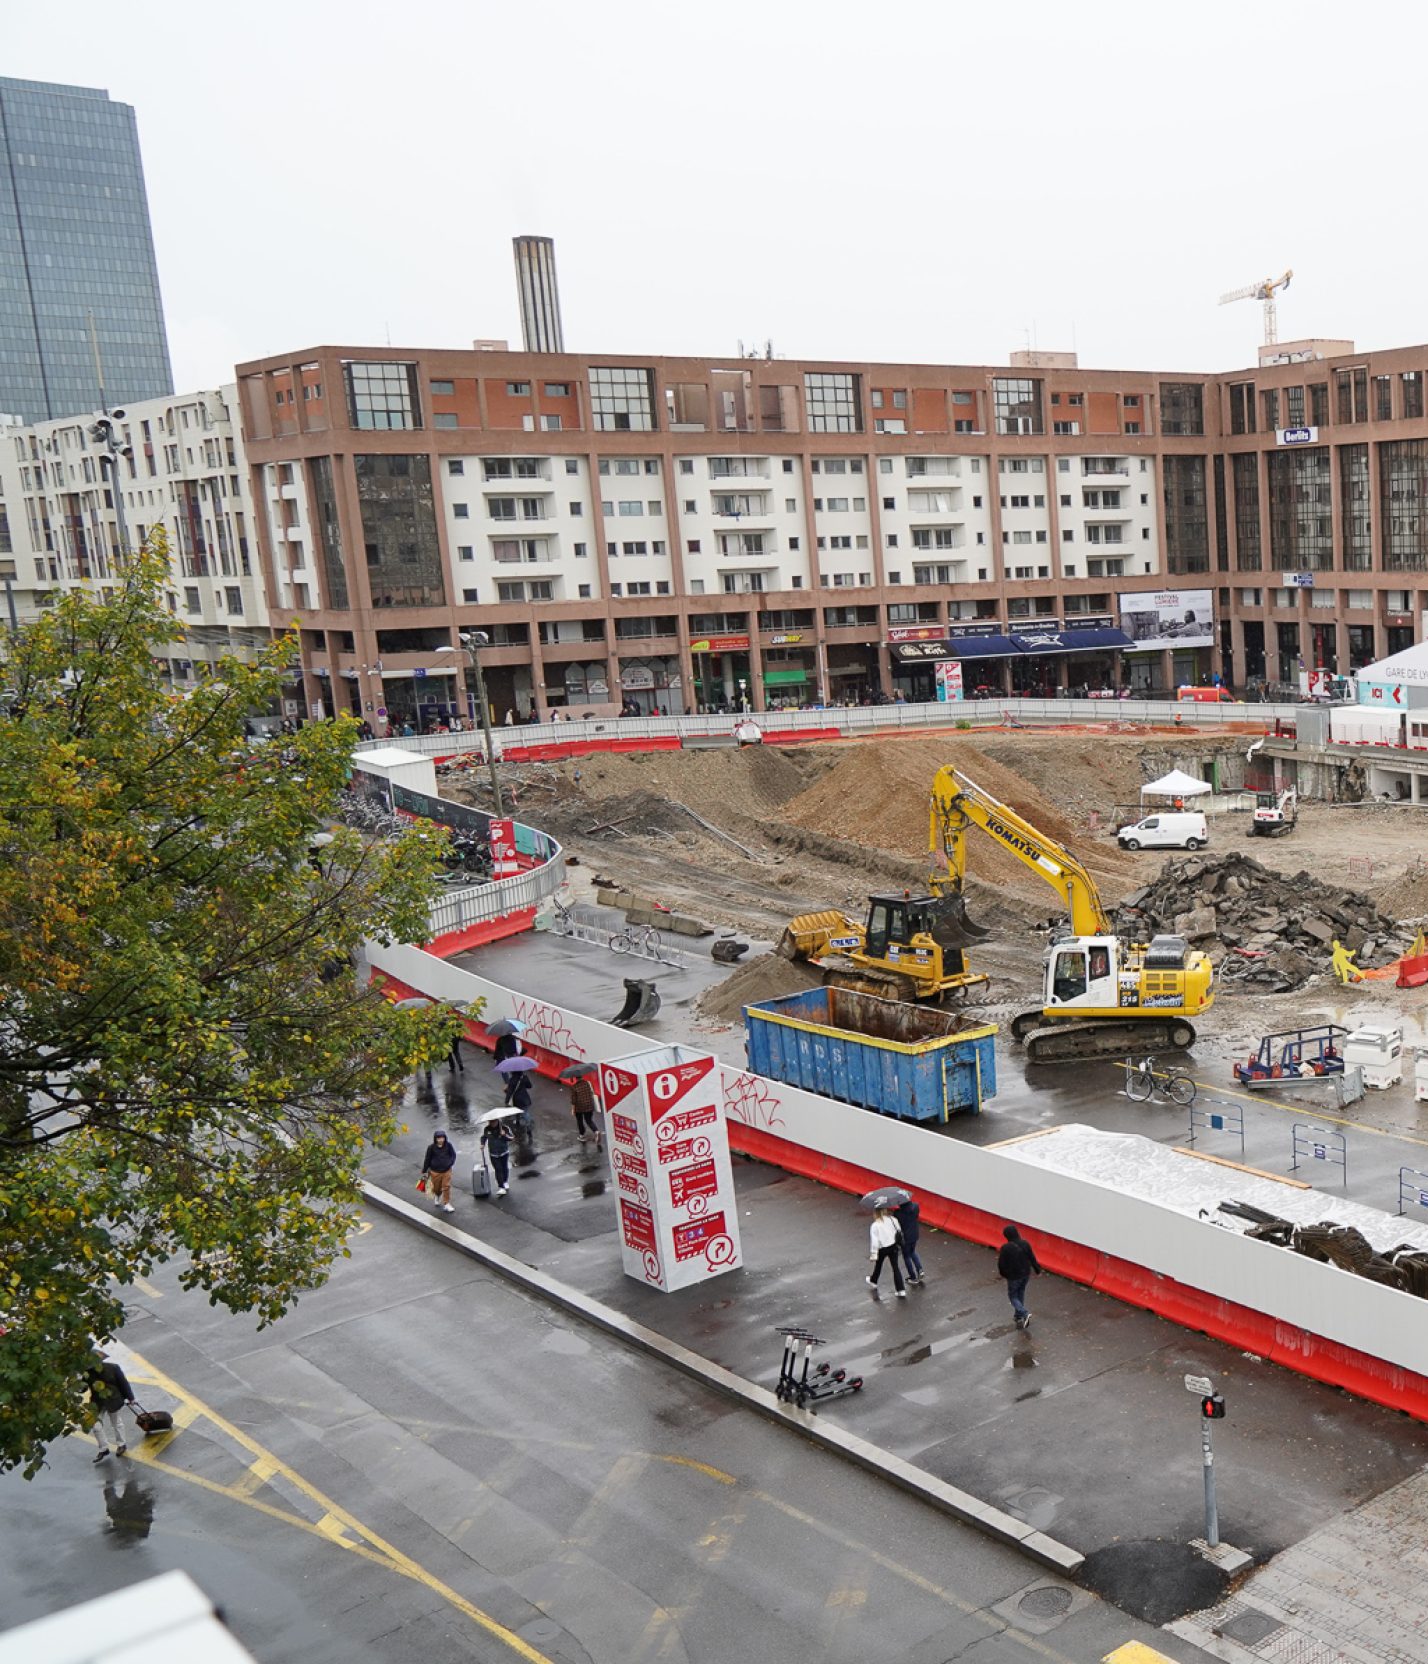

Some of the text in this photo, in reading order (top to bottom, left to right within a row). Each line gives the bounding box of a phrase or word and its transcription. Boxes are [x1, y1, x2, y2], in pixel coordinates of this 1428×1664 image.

[1385, 667, 1405, 679] GARE
[1407, 669, 1418, 680] DE
[1371, 688, 1383, 699] ICI
[986, 818, 1040, 861] KOMATSU
